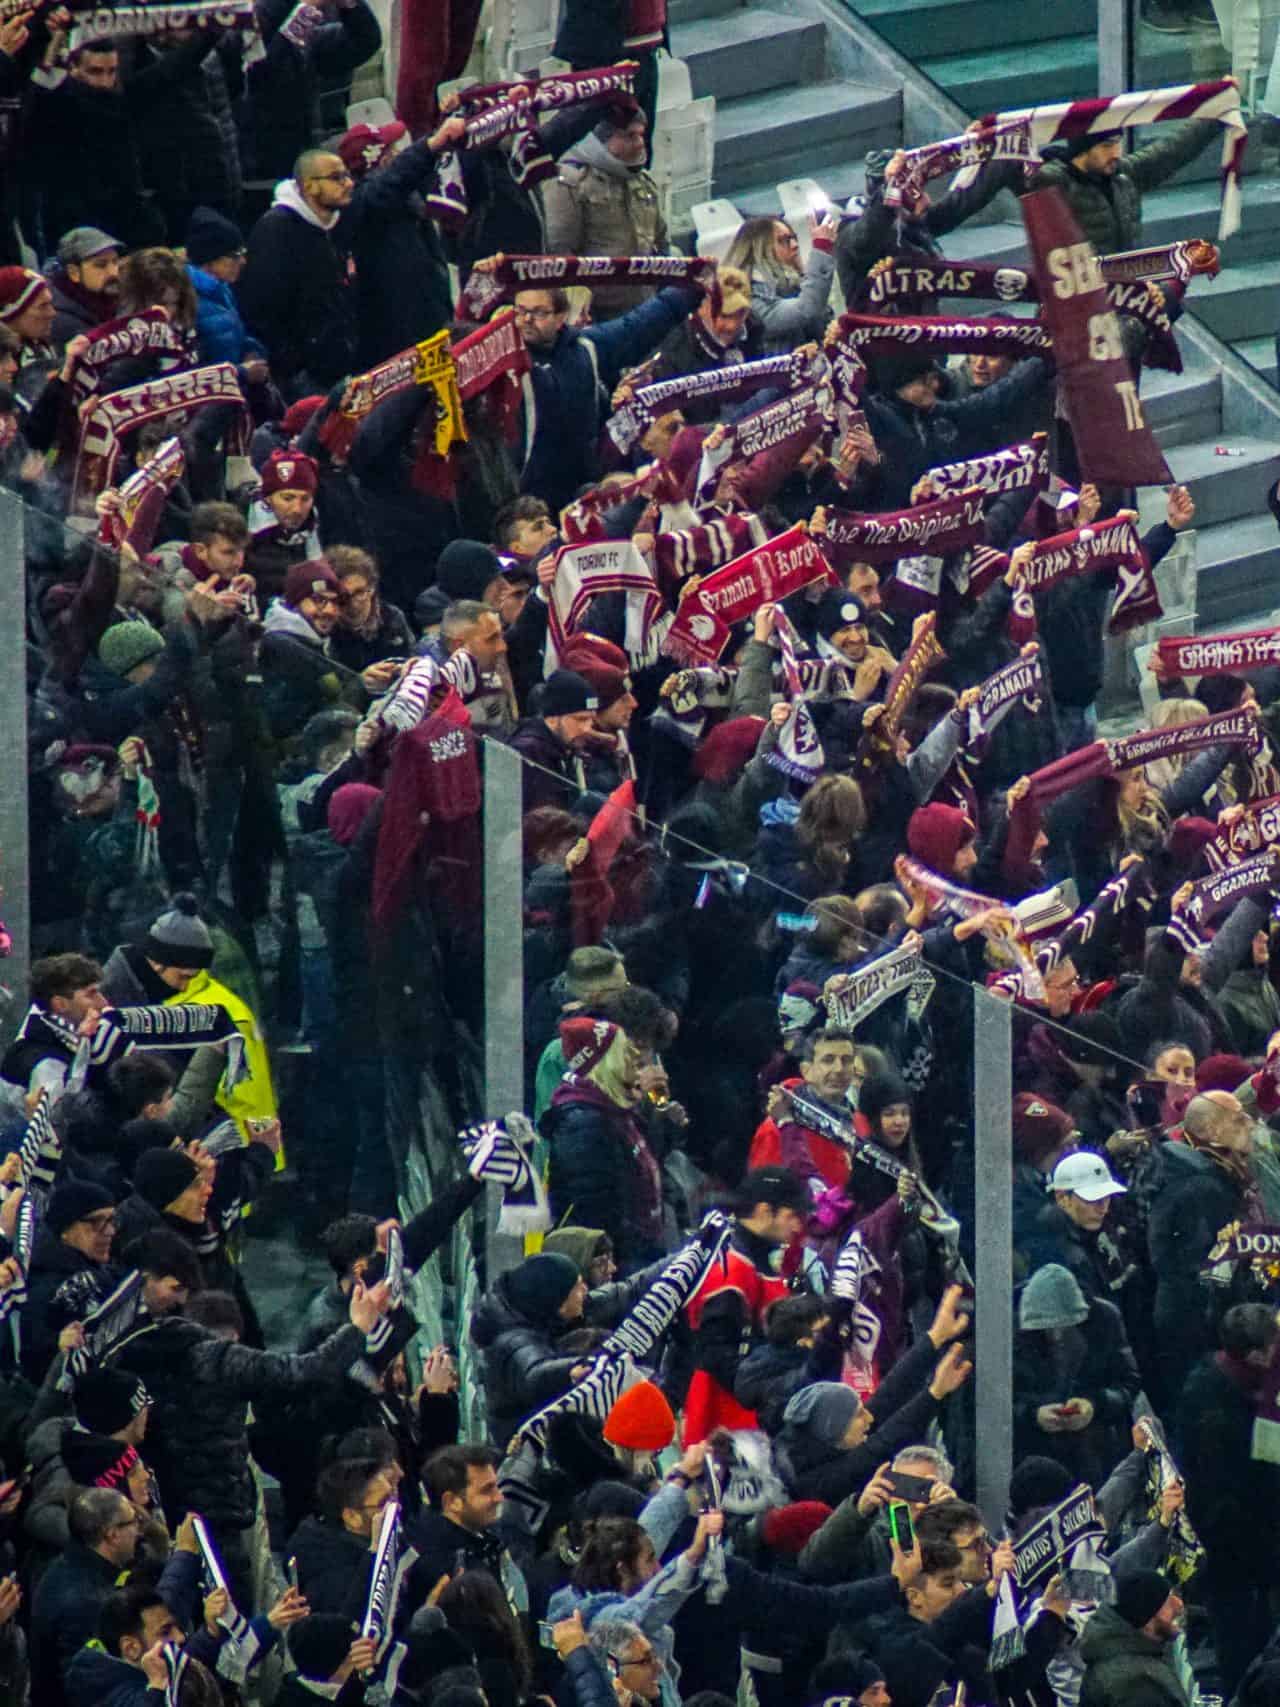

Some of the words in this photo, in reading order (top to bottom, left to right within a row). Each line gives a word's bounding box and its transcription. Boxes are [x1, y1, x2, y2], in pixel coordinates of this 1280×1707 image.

[75, 9, 197, 40] TORINO
[513, 260, 567, 281] TORO
[576, 257, 617, 276] NEL
[83, 366, 243, 457] ULTRAS
[864, 520, 897, 543] The
[606, 551, 620, 568] FC
[1179, 634, 1268, 671] GRANATA
[981, 666, 1035, 716] GRANATA
[1211, 866, 1273, 903] GRANATA
[604, 1313, 648, 1358] FINO
[641, 1276, 681, 1338] ALLA
[672, 1239, 712, 1289] FINE
